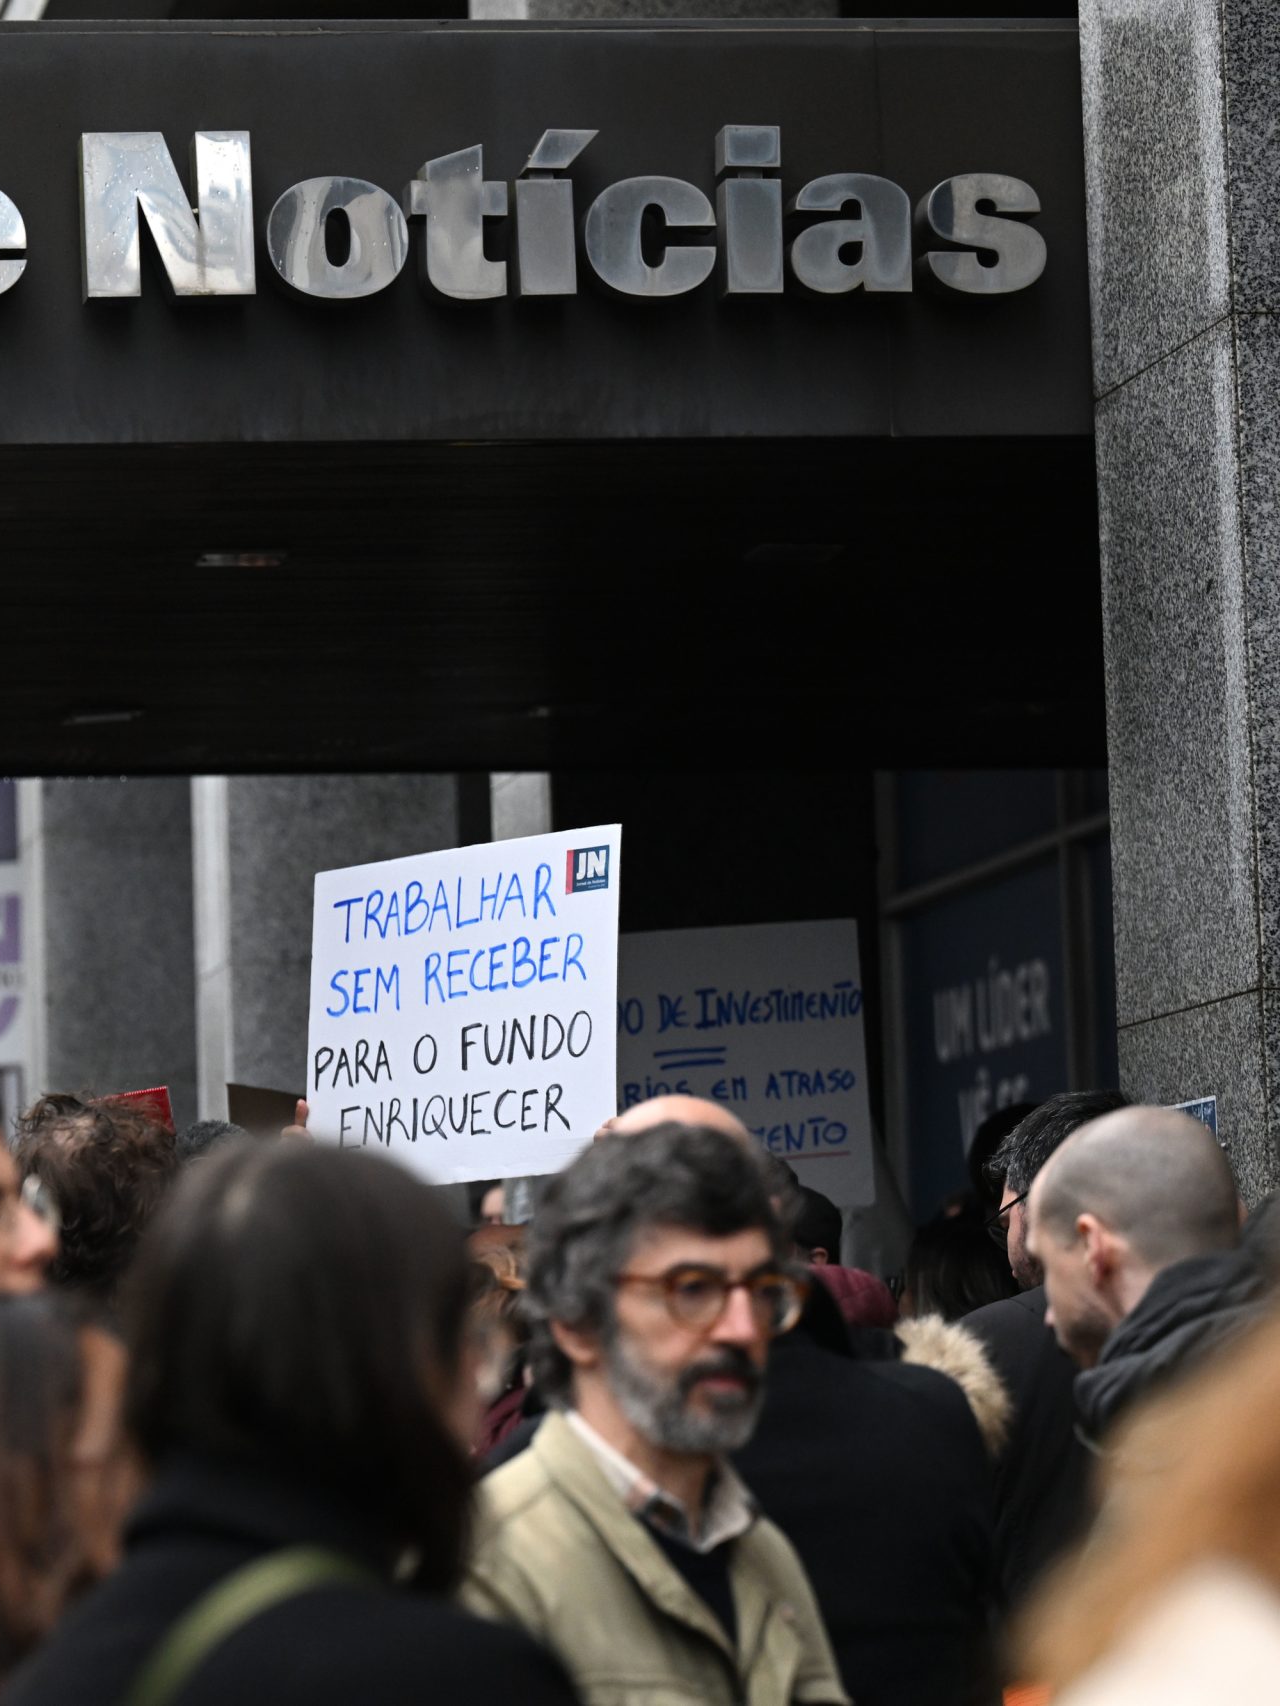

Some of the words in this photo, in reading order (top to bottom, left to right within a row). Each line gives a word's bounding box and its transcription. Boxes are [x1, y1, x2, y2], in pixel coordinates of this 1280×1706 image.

[82, 125, 1047, 300] Notícias
[576, 849, 607, 880] JN
[333, 863, 557, 944] TRABALHAR
[326, 964, 401, 1018] SEM
[424, 933, 587, 1006] RECEBER
[658, 995, 690, 1034] DE
[694, 981, 862, 1031] INVESTIMENTO
[314, 1039, 392, 1091] PARA
[413, 1034, 438, 1075] O
[461, 1011, 592, 1071] FUNDO
[711, 1076, 750, 1103] EM
[765, 1068, 856, 1100] ATRASO
[339, 1083, 571, 1149] ENRIQUECER
